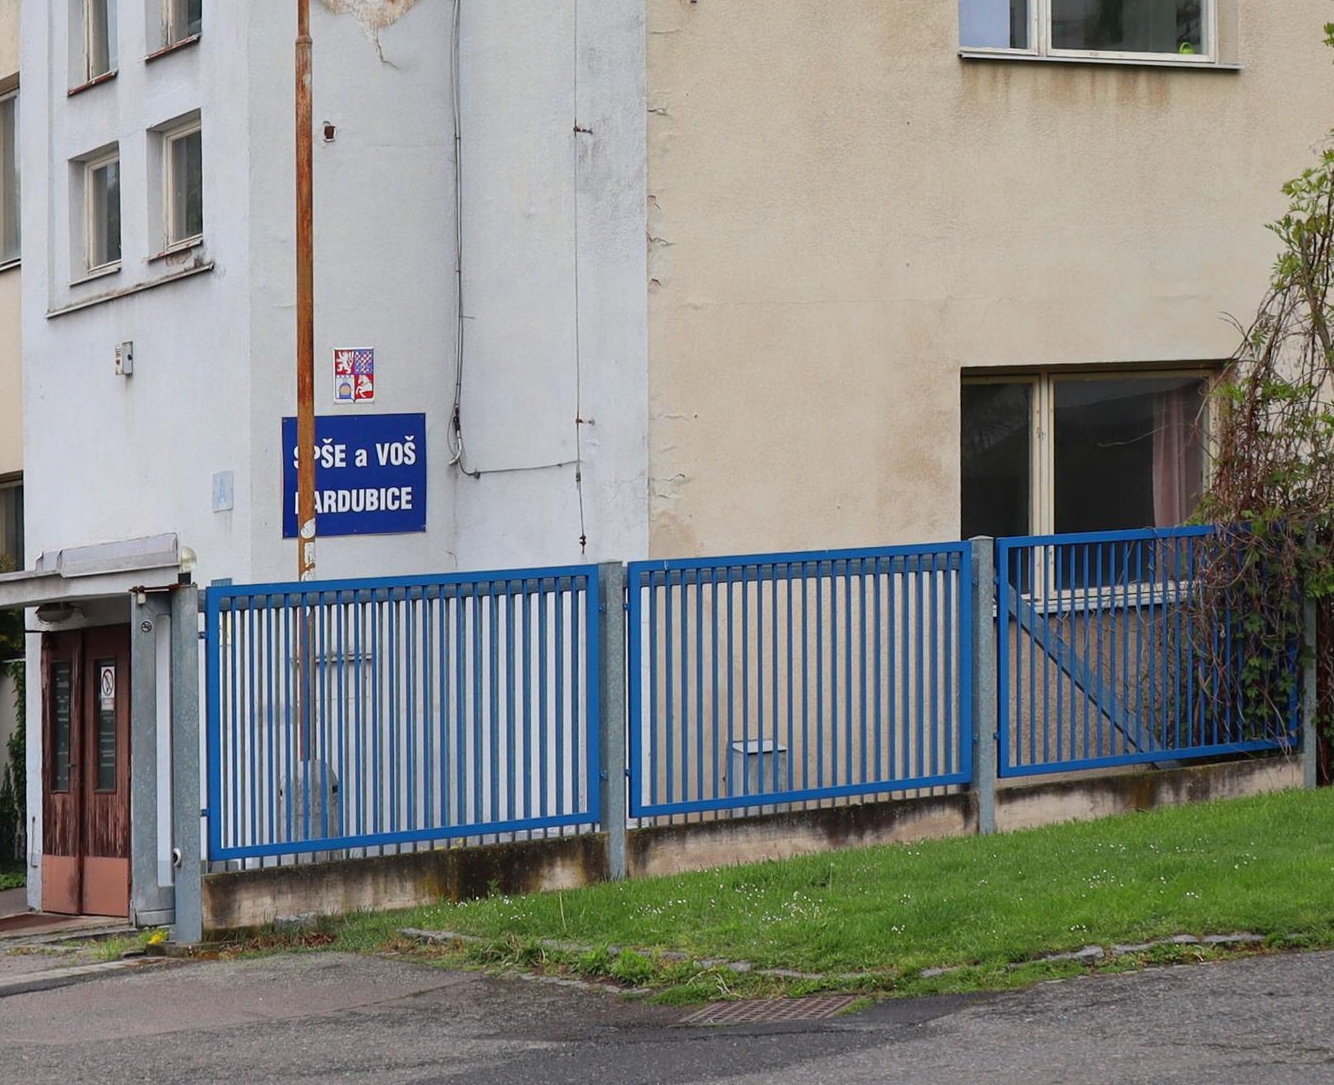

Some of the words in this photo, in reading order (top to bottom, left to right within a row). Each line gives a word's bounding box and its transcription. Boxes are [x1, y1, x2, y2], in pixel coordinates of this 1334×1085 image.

[354, 448, 368, 467] a
[375, 435, 416, 466] VOŠ
[295, 487, 412, 515] ARDUBICE
